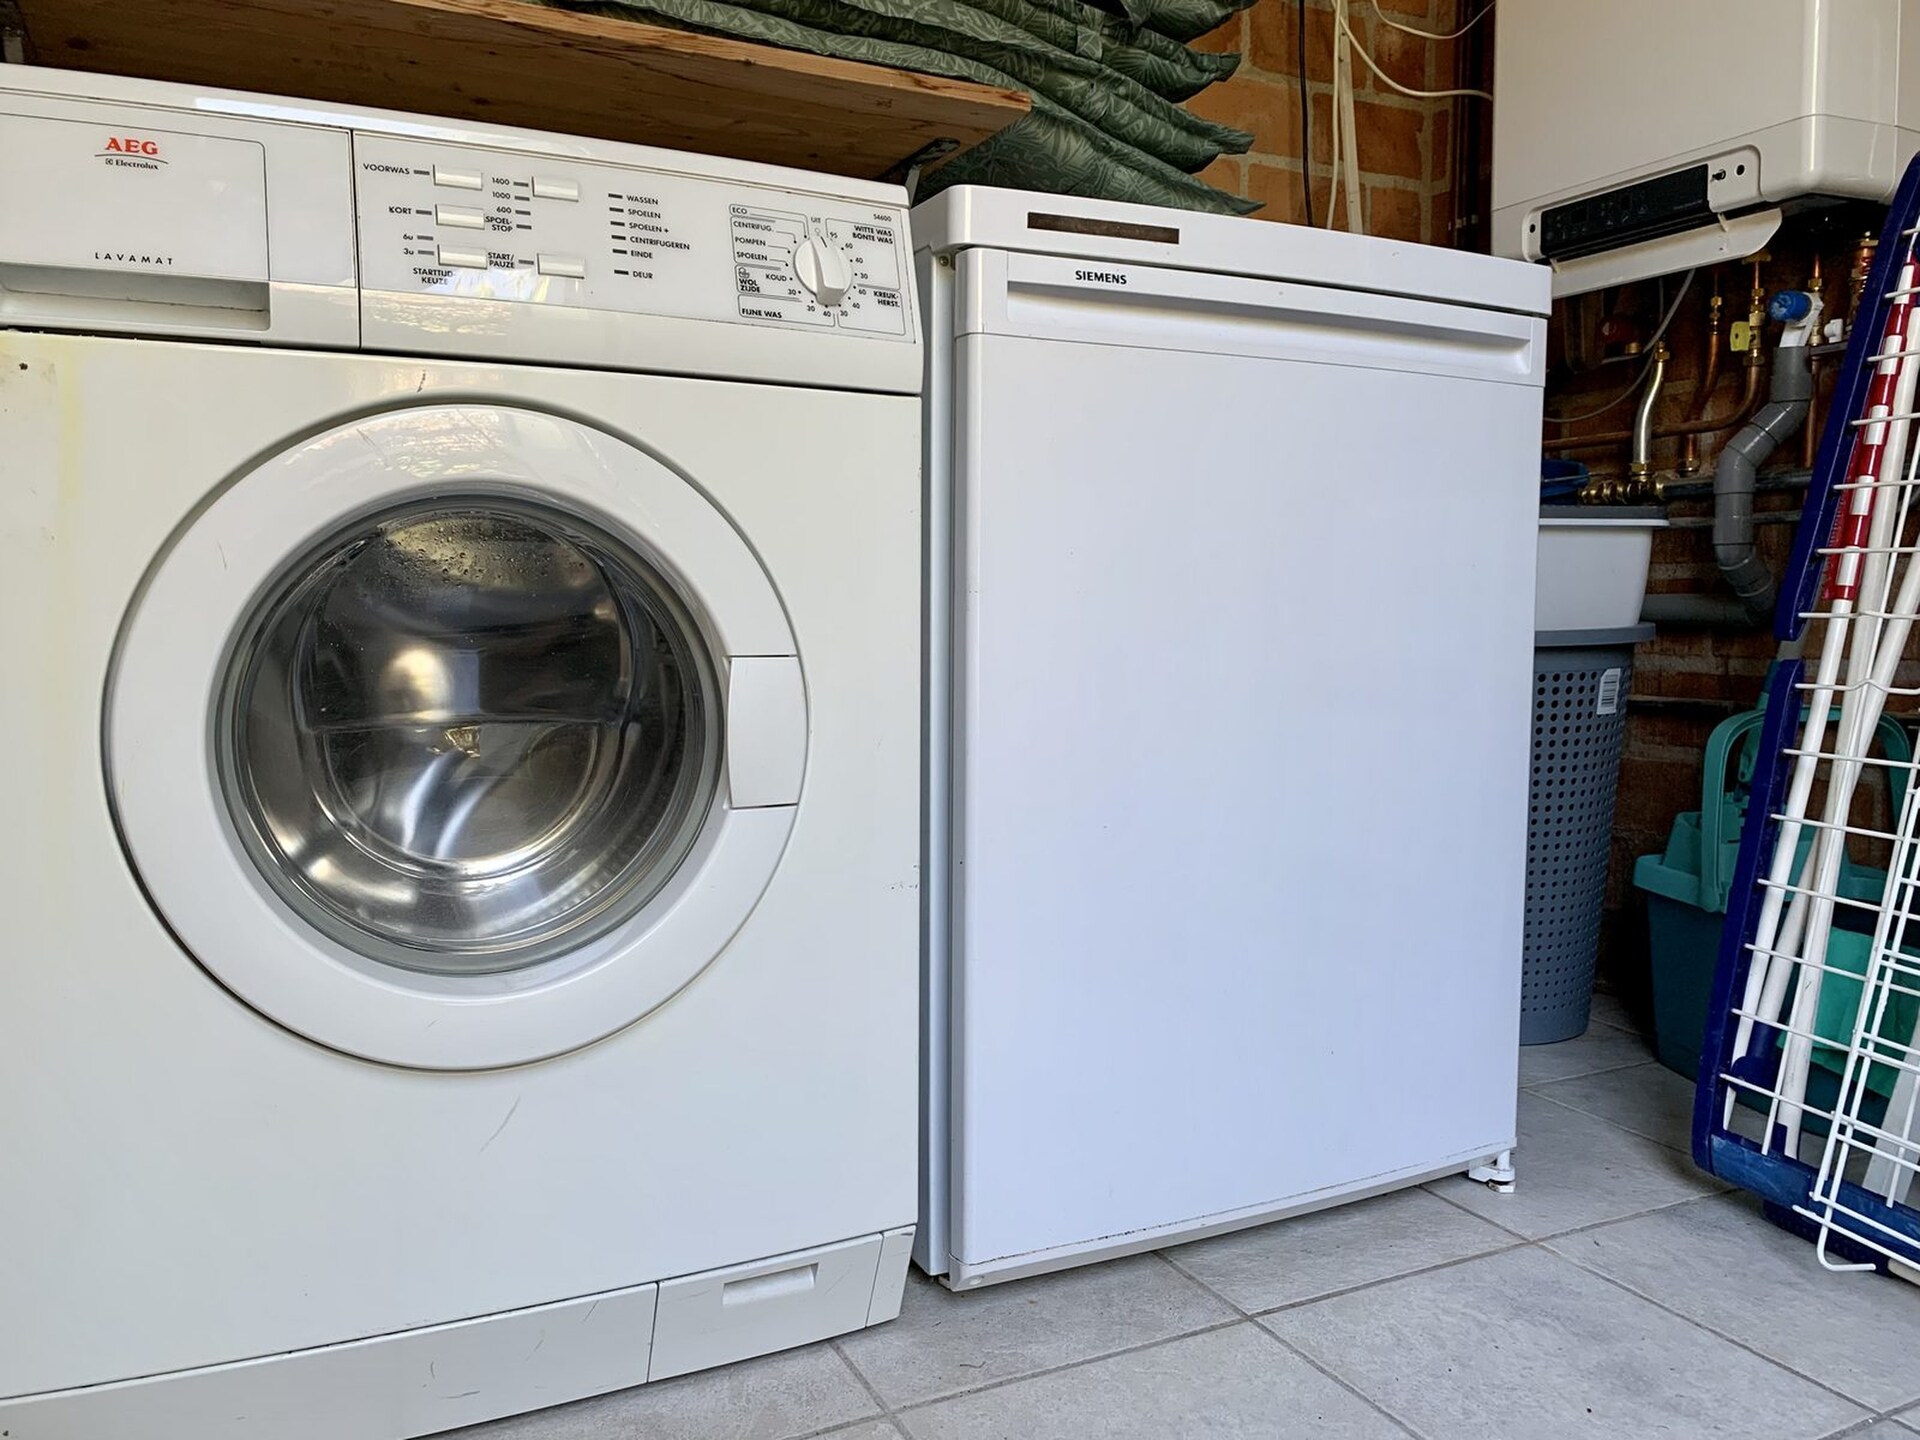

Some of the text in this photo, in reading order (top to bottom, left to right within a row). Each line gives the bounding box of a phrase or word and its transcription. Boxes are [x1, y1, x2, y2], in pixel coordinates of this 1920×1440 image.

[105, 137, 158, 155] AEG
[115, 159, 159, 170] Electrolux
[363, 163, 410, 175] VOORWAS
[492, 177, 510, 186] 1400
[492, 191, 511, 200] 1000
[626, 195, 658, 205] WASSEN
[389, 206, 412, 215] KORT
[496, 206, 512, 214] 600
[627, 208, 661, 219] SPOELEN
[732, 207, 748, 215] ECO
[810, 216, 821, 224] UIT
[873, 213, 892, 222] 54600
[491, 224, 513, 232] STOP
[628, 222, 662, 233] SPOELEN
[854, 225, 892, 237] WITTE WAS
[630, 236, 690, 250] CENTRIFUGEREN
[735, 236, 766, 246] POMPEN
[852, 232, 894, 245] BONTE WAS
[95, 252, 173, 265] LAVAMAT
[630, 249, 653, 259] EINDE
[736, 251, 768, 261] SPOELEN
[489, 259, 515, 269] PAUZE
[632, 270, 654, 279] DEUR
[765, 273, 787, 282] KOUD
[1075, 270, 1127, 285] SIEMENS
[421, 276, 448, 285] KEUZE
[739, 278, 758, 286] WOL
[740, 284, 761, 293] ZIJDE
[741, 308, 782, 319] FIJNE WAS
